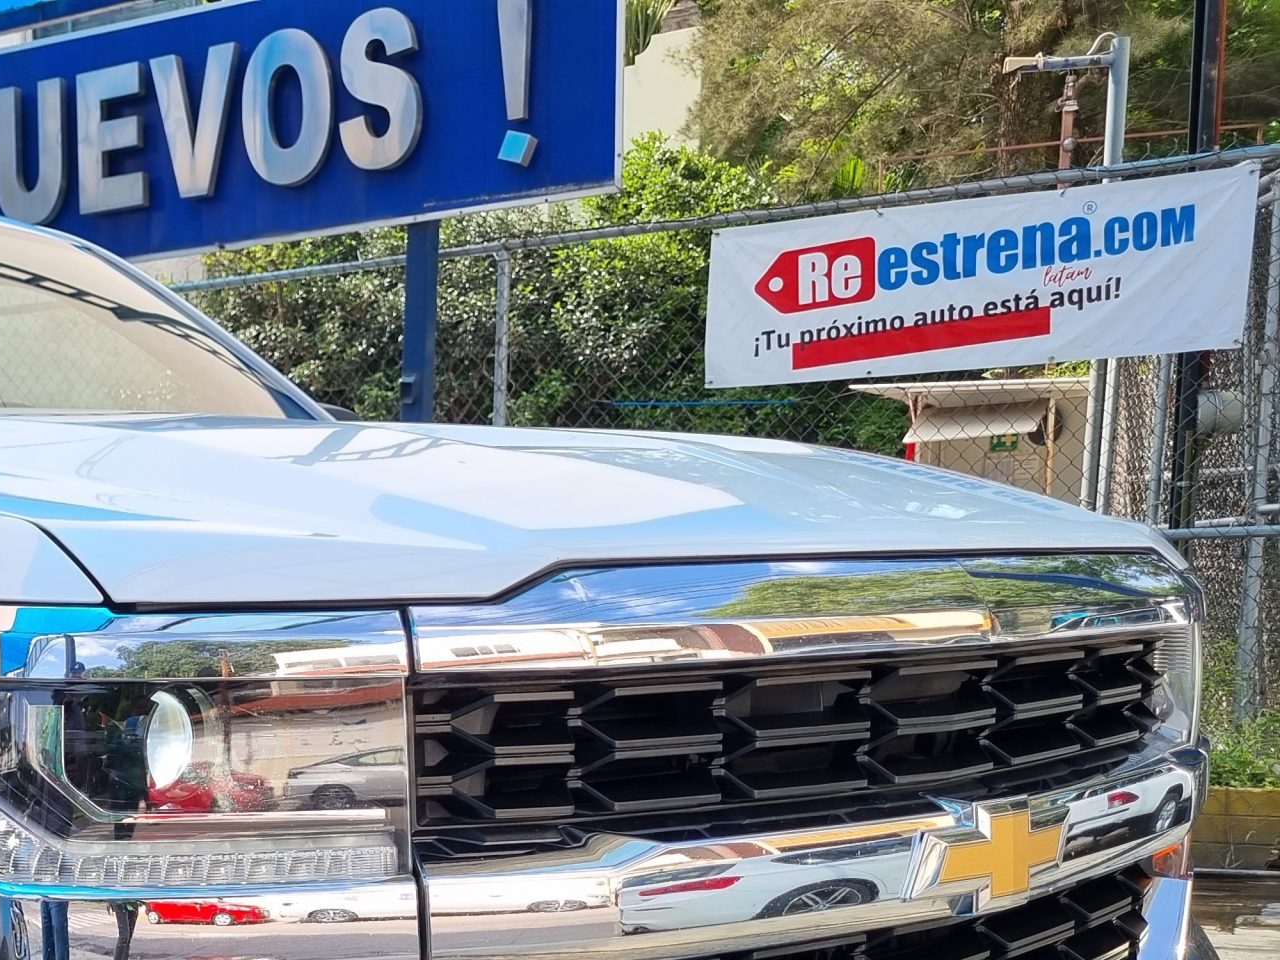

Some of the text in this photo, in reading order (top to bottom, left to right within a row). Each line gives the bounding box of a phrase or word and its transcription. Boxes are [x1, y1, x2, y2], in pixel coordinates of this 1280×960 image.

[1043, 265, 1093, 287] latam
[754, 276, 1122, 357] ¡Tu próximo auto está aquí!
